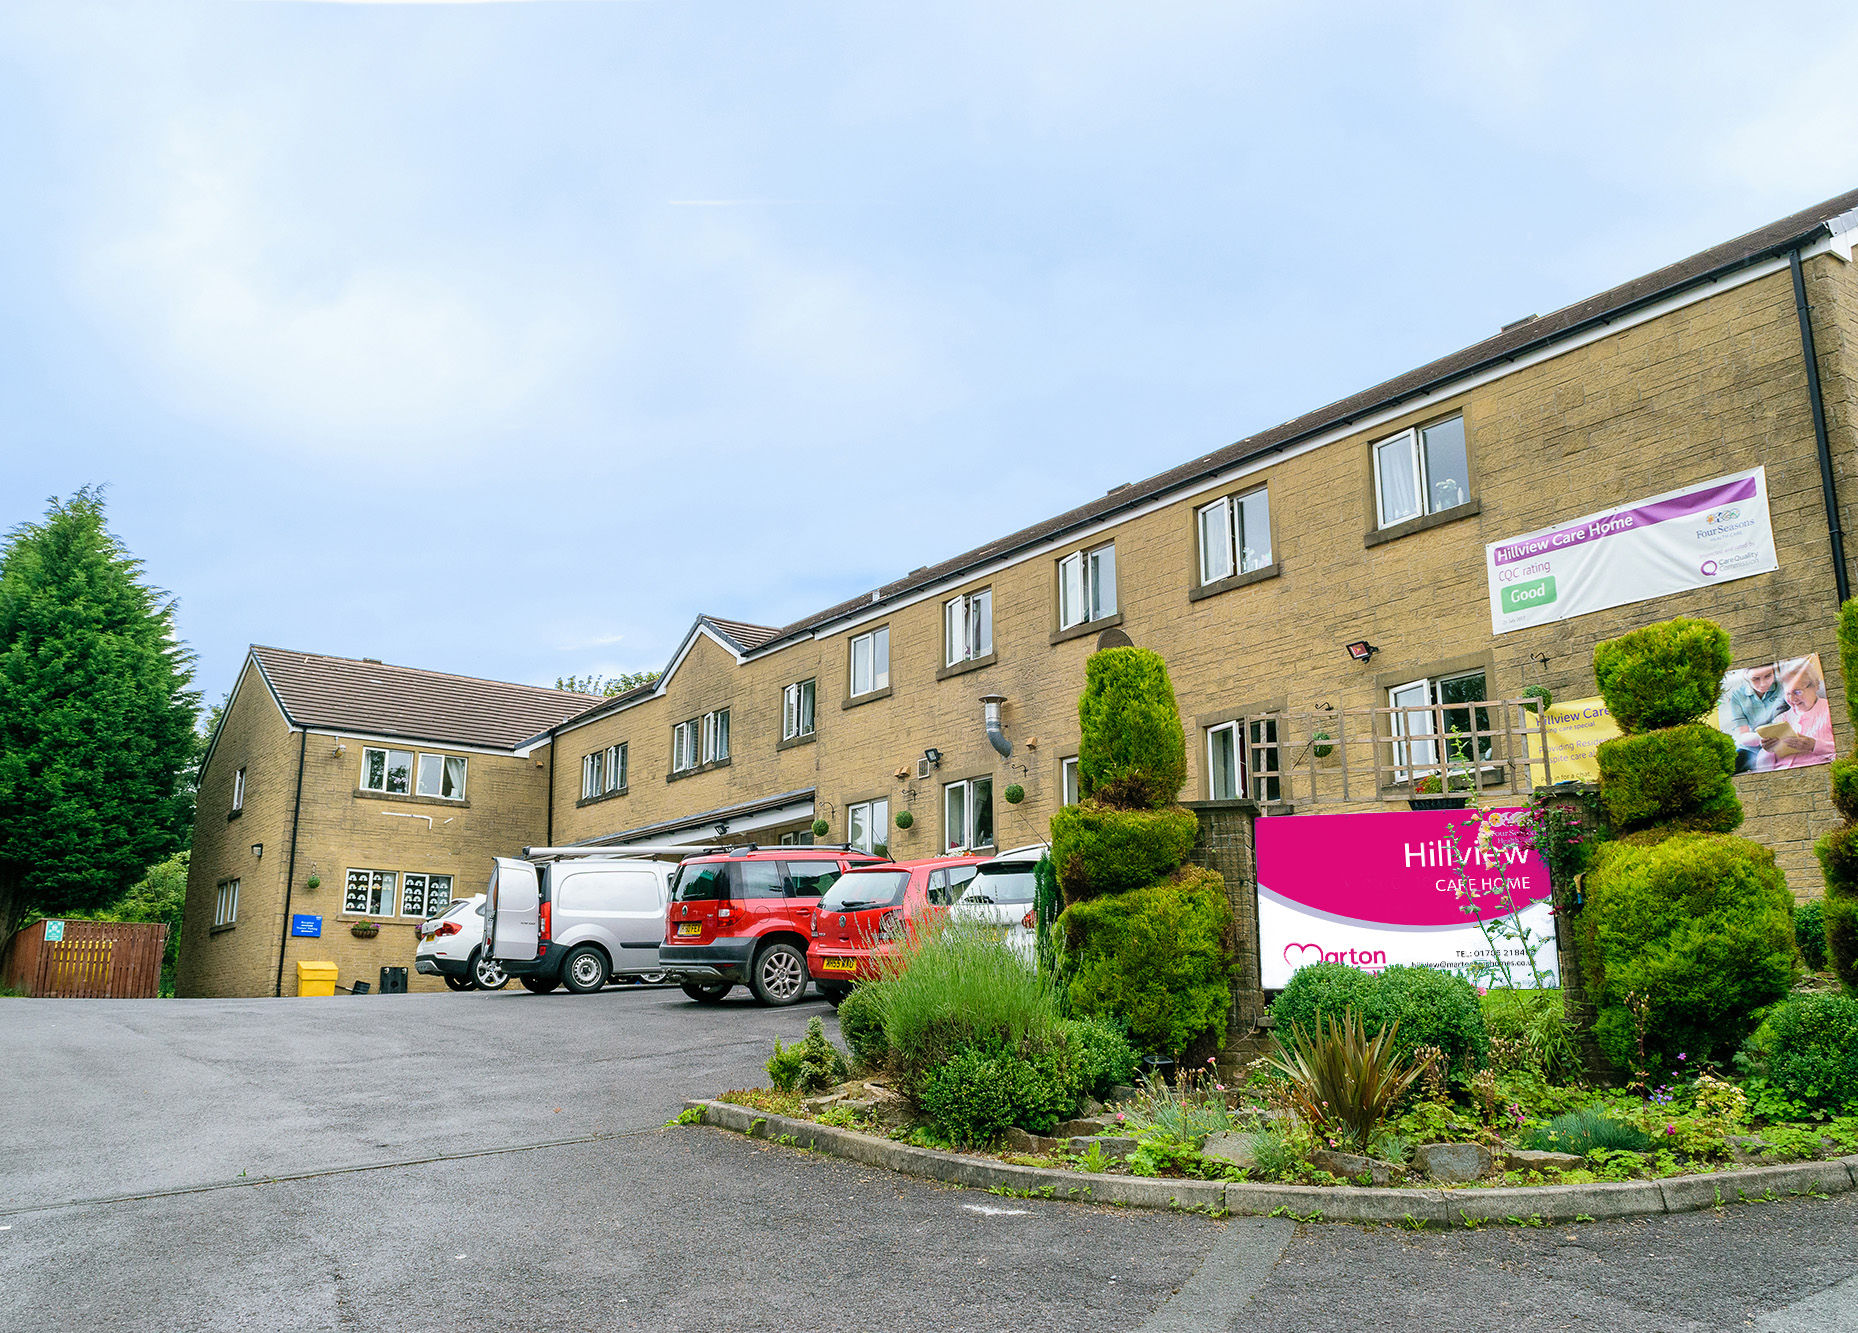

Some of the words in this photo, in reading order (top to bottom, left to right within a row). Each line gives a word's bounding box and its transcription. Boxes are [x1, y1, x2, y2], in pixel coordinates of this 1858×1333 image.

[1696, 528, 1717, 539] Four
[1717, 519, 1755, 534] Seasons
[1497, 538, 1549, 562] Hillview
[1552, 529, 1586, 547] Care
[1588, 515, 1634, 537] Home
[1719, 557, 1734, 566] Care
[1734, 551, 1759, 562] Quality
[1719, 558, 1760, 572] Commission
[1498, 567, 1520, 582] CQC
[1522, 561, 1551, 577] rating
[1510, 583, 1545, 603] Good
[1583, 707, 1611, 719] Care
[1574, 721, 1596, 731] special
[1538, 742, 1575, 754] Poviding
[1570, 752, 1587, 761] care
[1404, 839, 1529, 868] Hillview
[1481, 876, 1531, 891] HOME
